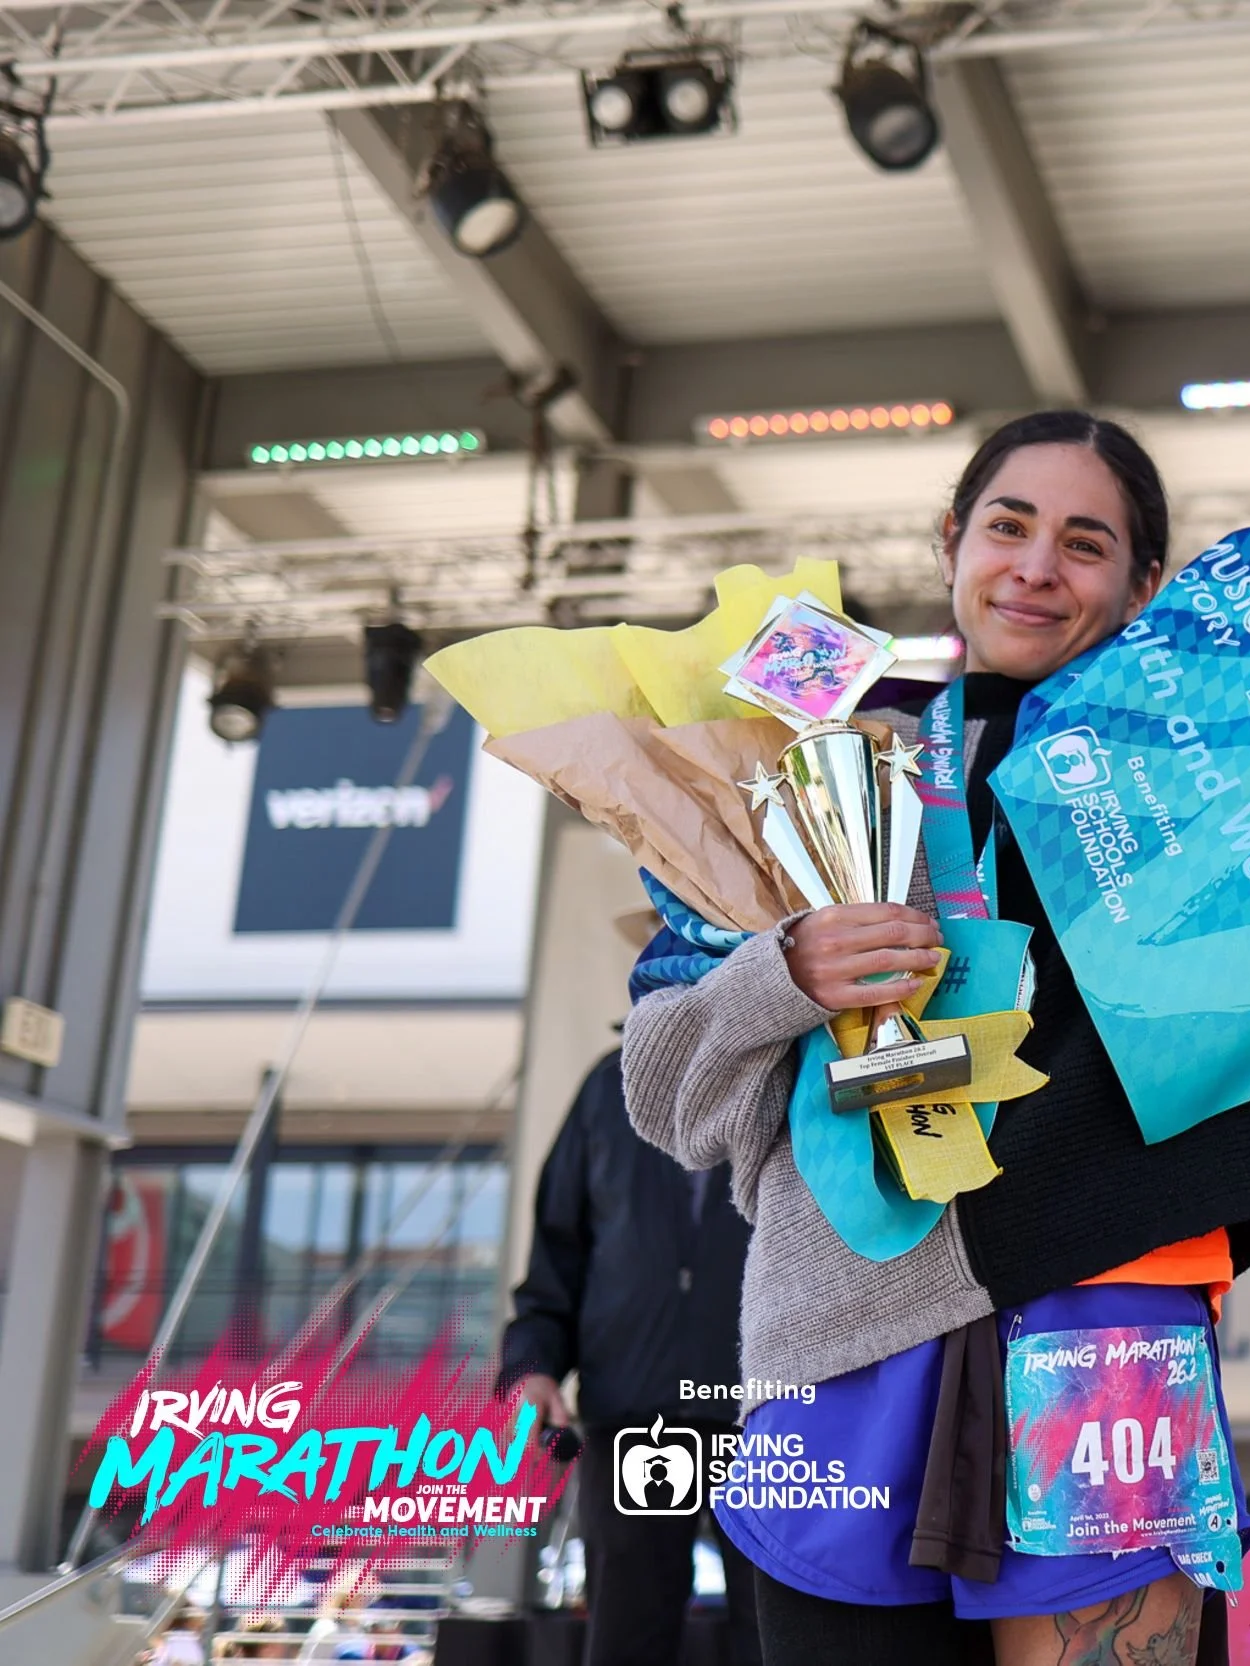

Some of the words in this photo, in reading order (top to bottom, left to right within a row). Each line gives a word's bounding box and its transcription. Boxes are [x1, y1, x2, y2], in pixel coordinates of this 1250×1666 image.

[930, 748, 957, 790] IRVING
[1166, 714, 1242, 801] and
[265, 777, 432, 830] verizon
[1099, 789, 1139, 855] IRVING
[1127, 755, 1183, 858] Benefiting
[1066, 796, 1130, 924] FOUNDATION
[1083, 791, 1134, 888] SCHOOLS
[1023, 1343, 1097, 1376] IRVING
[1104, 1332, 1197, 1369] MARATHON
[1071, 1416, 1176, 1487] 404
[1066, 1522, 1100, 1538] Join
[1104, 1520, 1128, 1534] the
[1132, 1513, 1197, 1532] Movement
[1192, 1551, 1213, 1564] CHECK
